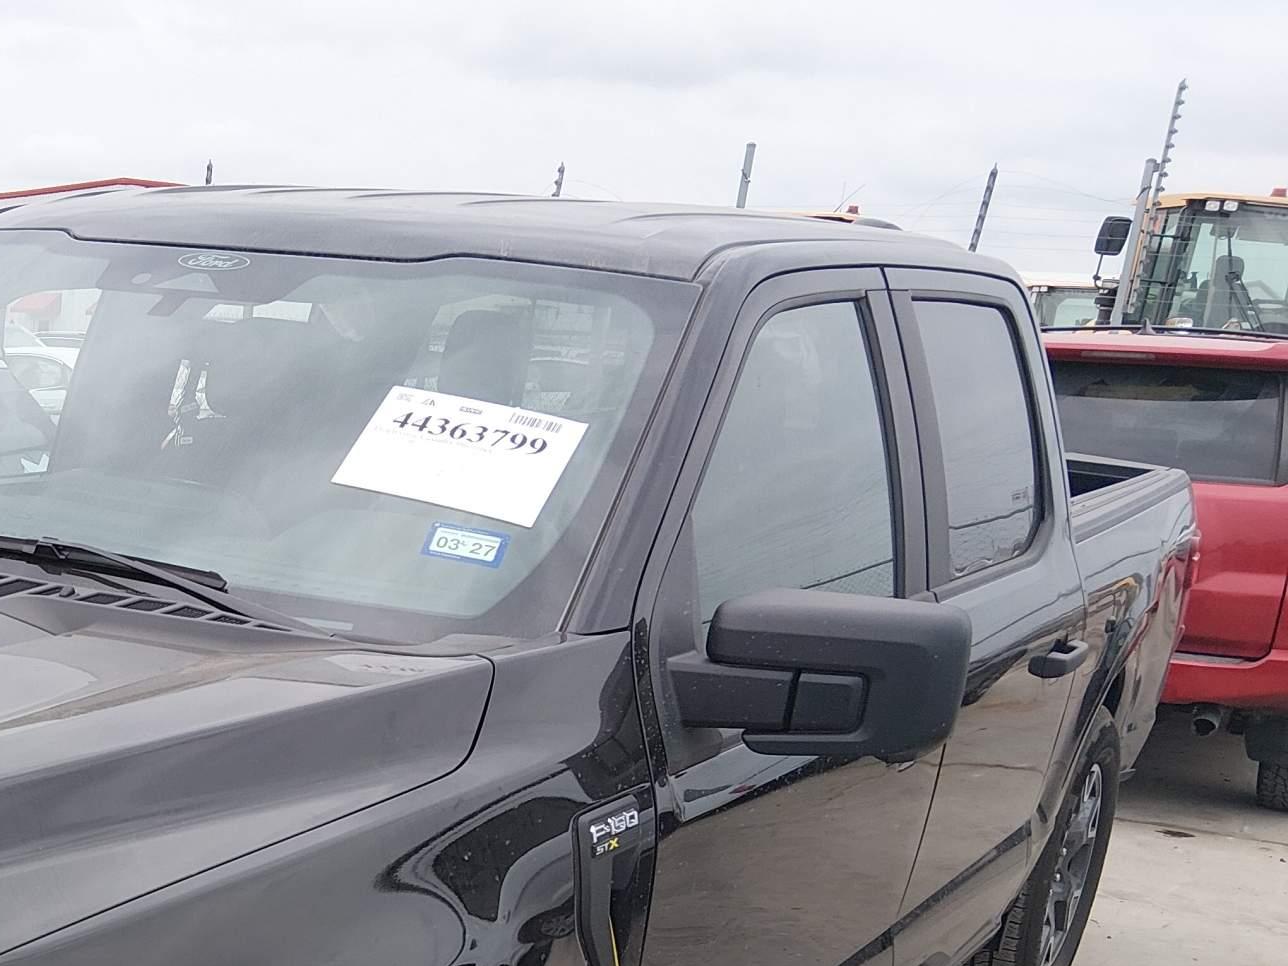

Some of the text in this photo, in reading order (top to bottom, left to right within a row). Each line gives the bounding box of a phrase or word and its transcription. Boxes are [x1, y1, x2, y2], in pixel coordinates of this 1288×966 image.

[187, 254, 239, 269] Ford
[392, 411, 549, 456] 44363799
[435, 536, 497, 557] 03 27
[589, 809, 640, 844] F-150
[595, 837, 620, 856] STX
